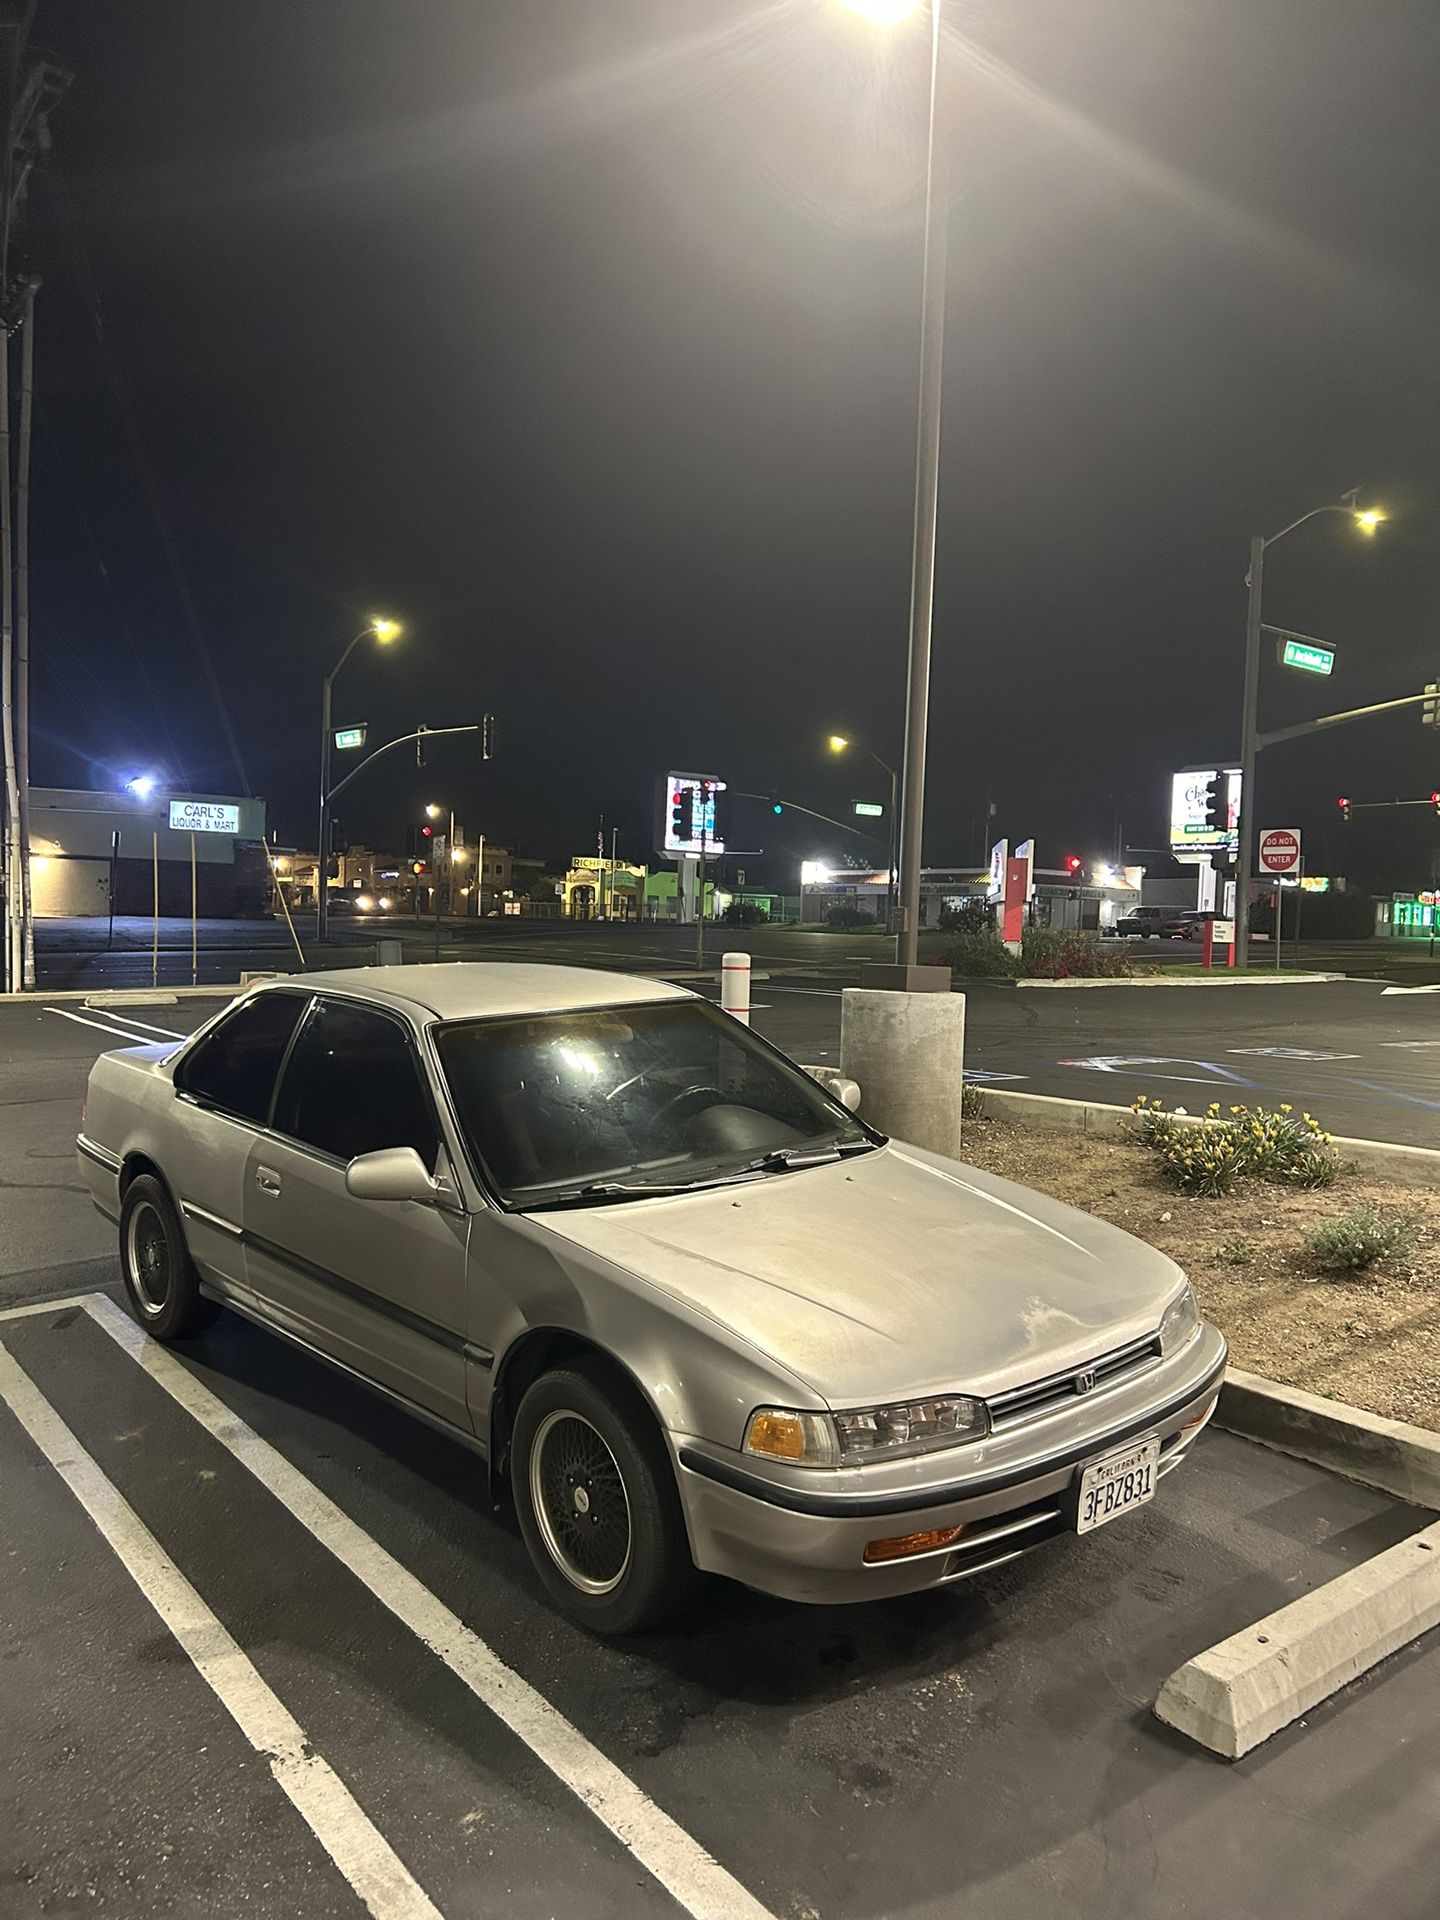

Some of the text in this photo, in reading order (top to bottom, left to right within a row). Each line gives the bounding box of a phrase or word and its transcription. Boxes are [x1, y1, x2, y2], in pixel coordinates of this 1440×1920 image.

[184, 804, 225, 819] CARL'S
[172, 817, 236, 831] LIQUOR & MART
[1278, 837, 1293, 845] NOT
[573, 858, 623, 869] RICHFIELD
[1083, 1463, 1151, 1521] 3FBZ831
